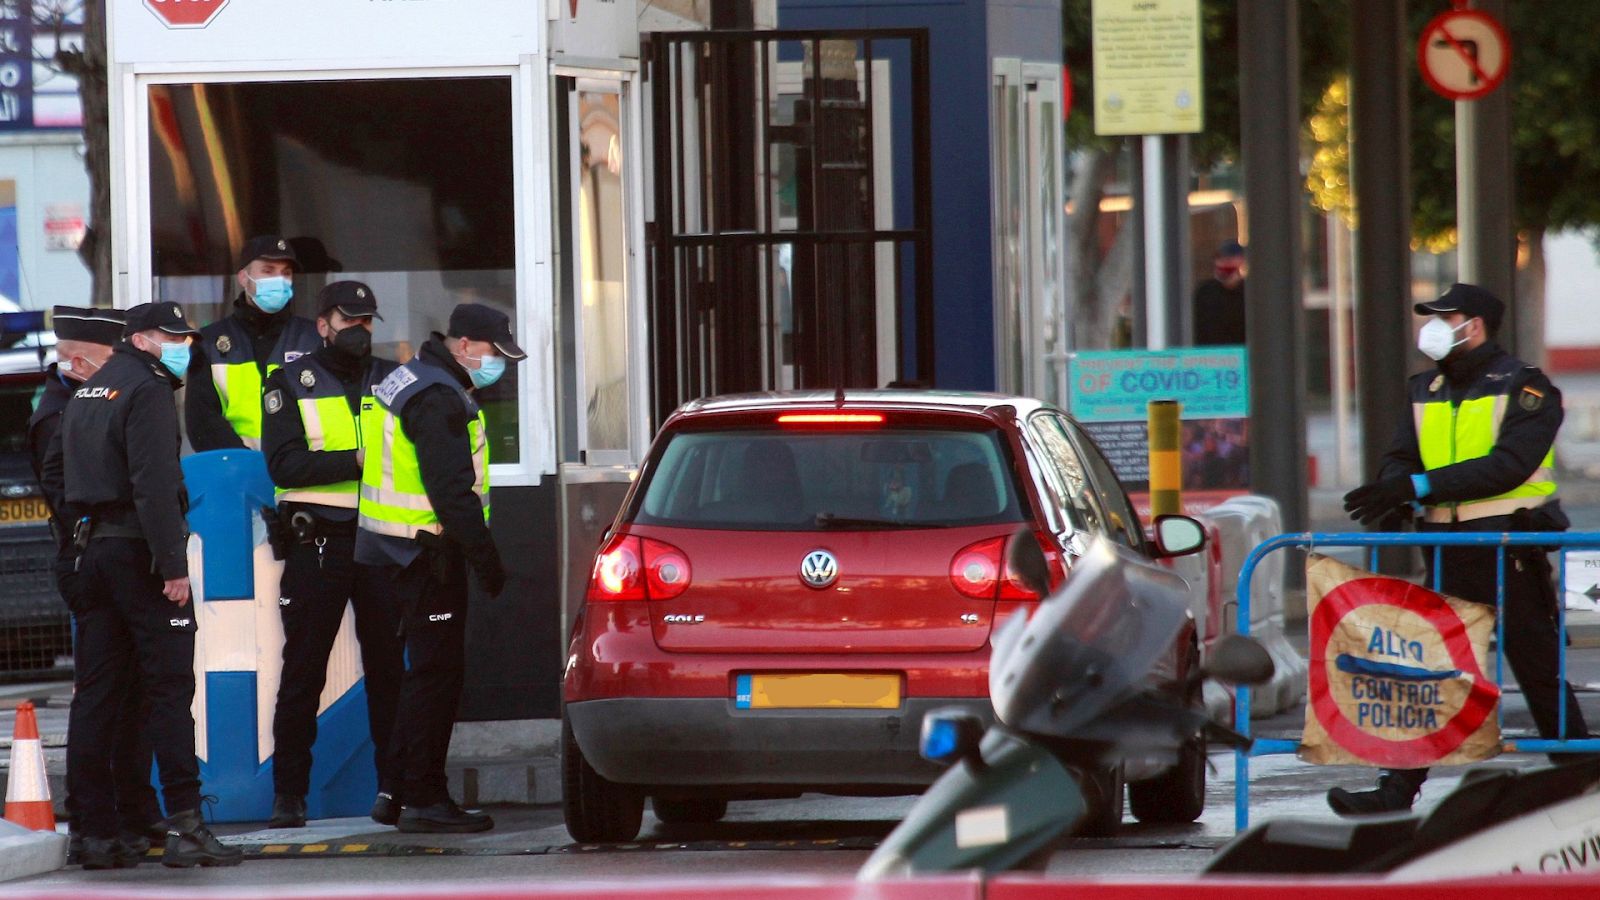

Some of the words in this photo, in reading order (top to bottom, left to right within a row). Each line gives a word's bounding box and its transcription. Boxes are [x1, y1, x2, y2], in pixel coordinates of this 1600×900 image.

[1079, 373, 1112, 395] OF
[1120, 369, 1239, 393] COVID-19
[74, 387, 109, 399] POLICIA
[169, 618, 190, 627] CNP
[429, 613, 452, 621] CNP
[663, 614, 705, 624] GOLF
[1352, 676, 1444, 706] CONTROL
[1358, 702, 1437, 730] POLICIA
